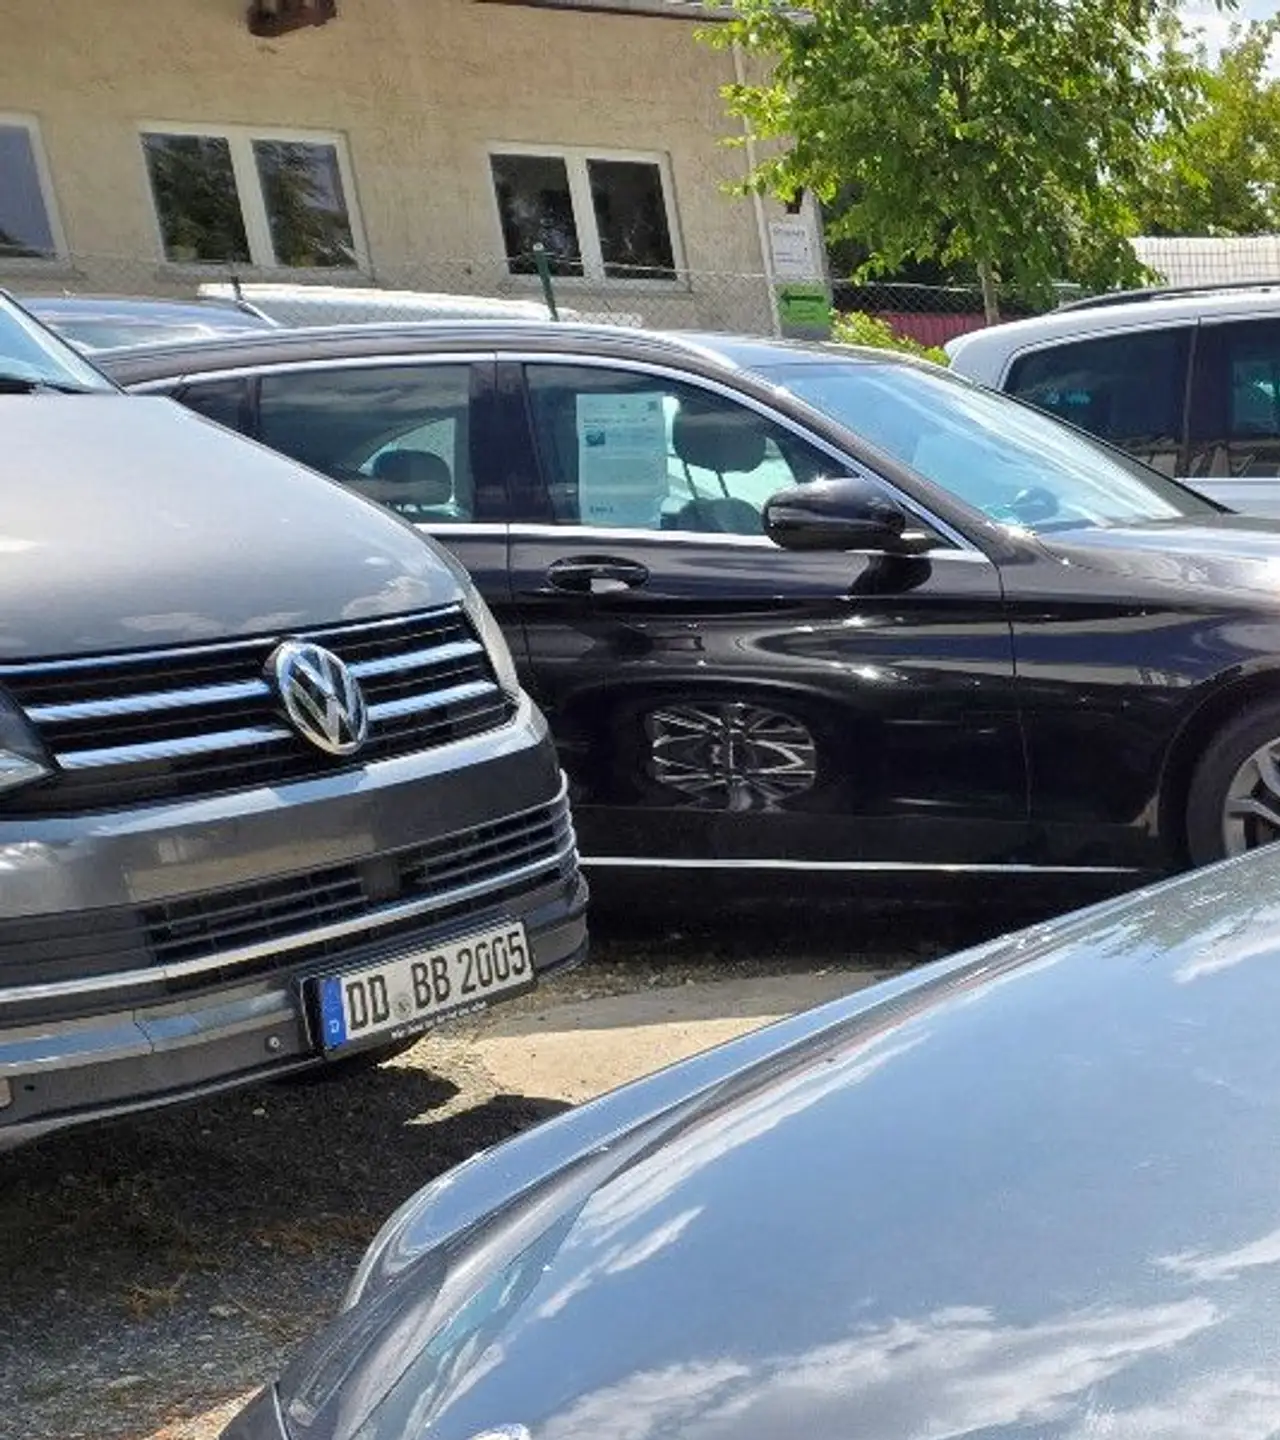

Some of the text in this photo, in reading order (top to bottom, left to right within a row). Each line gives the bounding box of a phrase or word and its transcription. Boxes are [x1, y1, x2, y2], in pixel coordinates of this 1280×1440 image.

[346, 974, 390, 1031] DD
[411, 955, 451, 1010] BB
[457, 931, 526, 995] 2005
